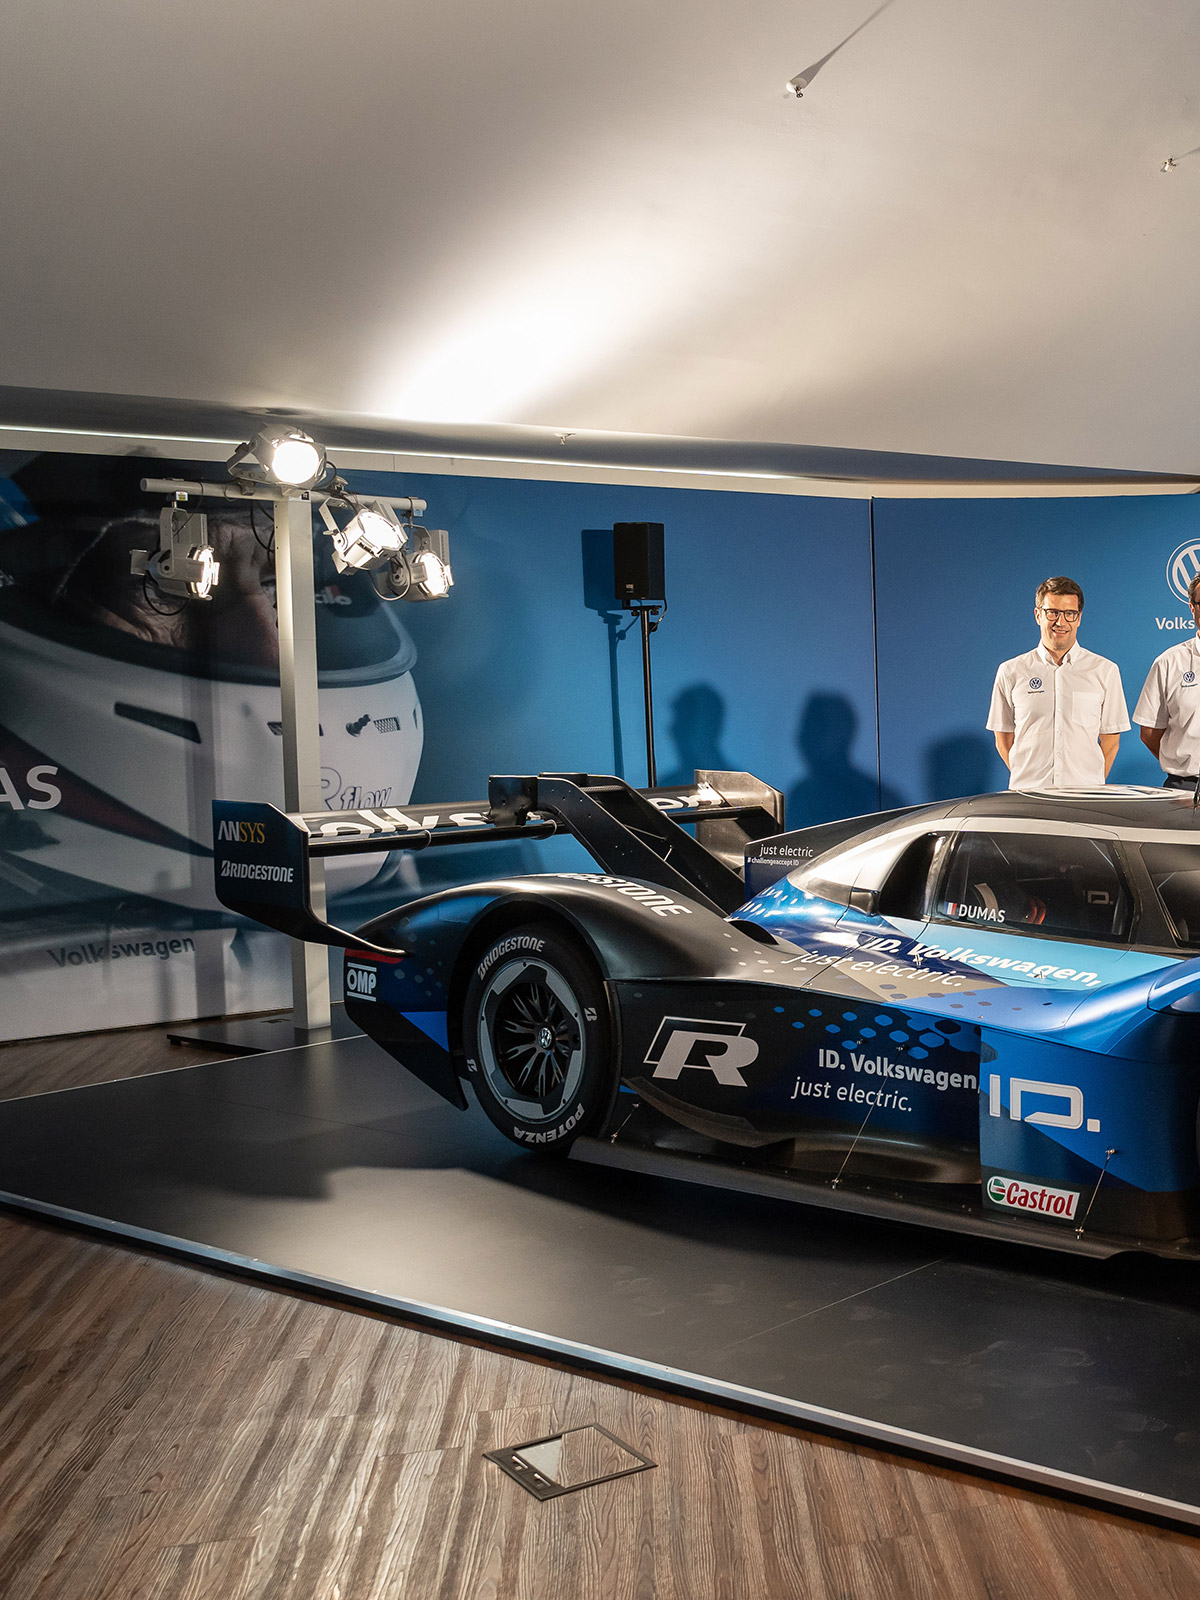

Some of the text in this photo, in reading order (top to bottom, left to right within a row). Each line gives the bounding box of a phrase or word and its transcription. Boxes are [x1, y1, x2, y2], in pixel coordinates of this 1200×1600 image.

[218, 820, 265, 844] ANSYS
[759, 844, 814, 858] just electric
[220, 860, 294, 883] BRIDGESTONE
[959, 903, 1006, 923] DUMAS
[47, 937, 195, 967] Volkswagen
[477, 936, 546, 981] BRIDGESTONE
[347, 968, 377, 995] OMP
[780, 951, 967, 987] just electric.
[819, 1049, 846, 1071] ID.
[791, 1076, 913, 1112] just electric.
[989, 1073, 1101, 1133] ID.
[513, 1103, 585, 1144] POTENZA
[1006, 1182, 1074, 1217] Castrol
